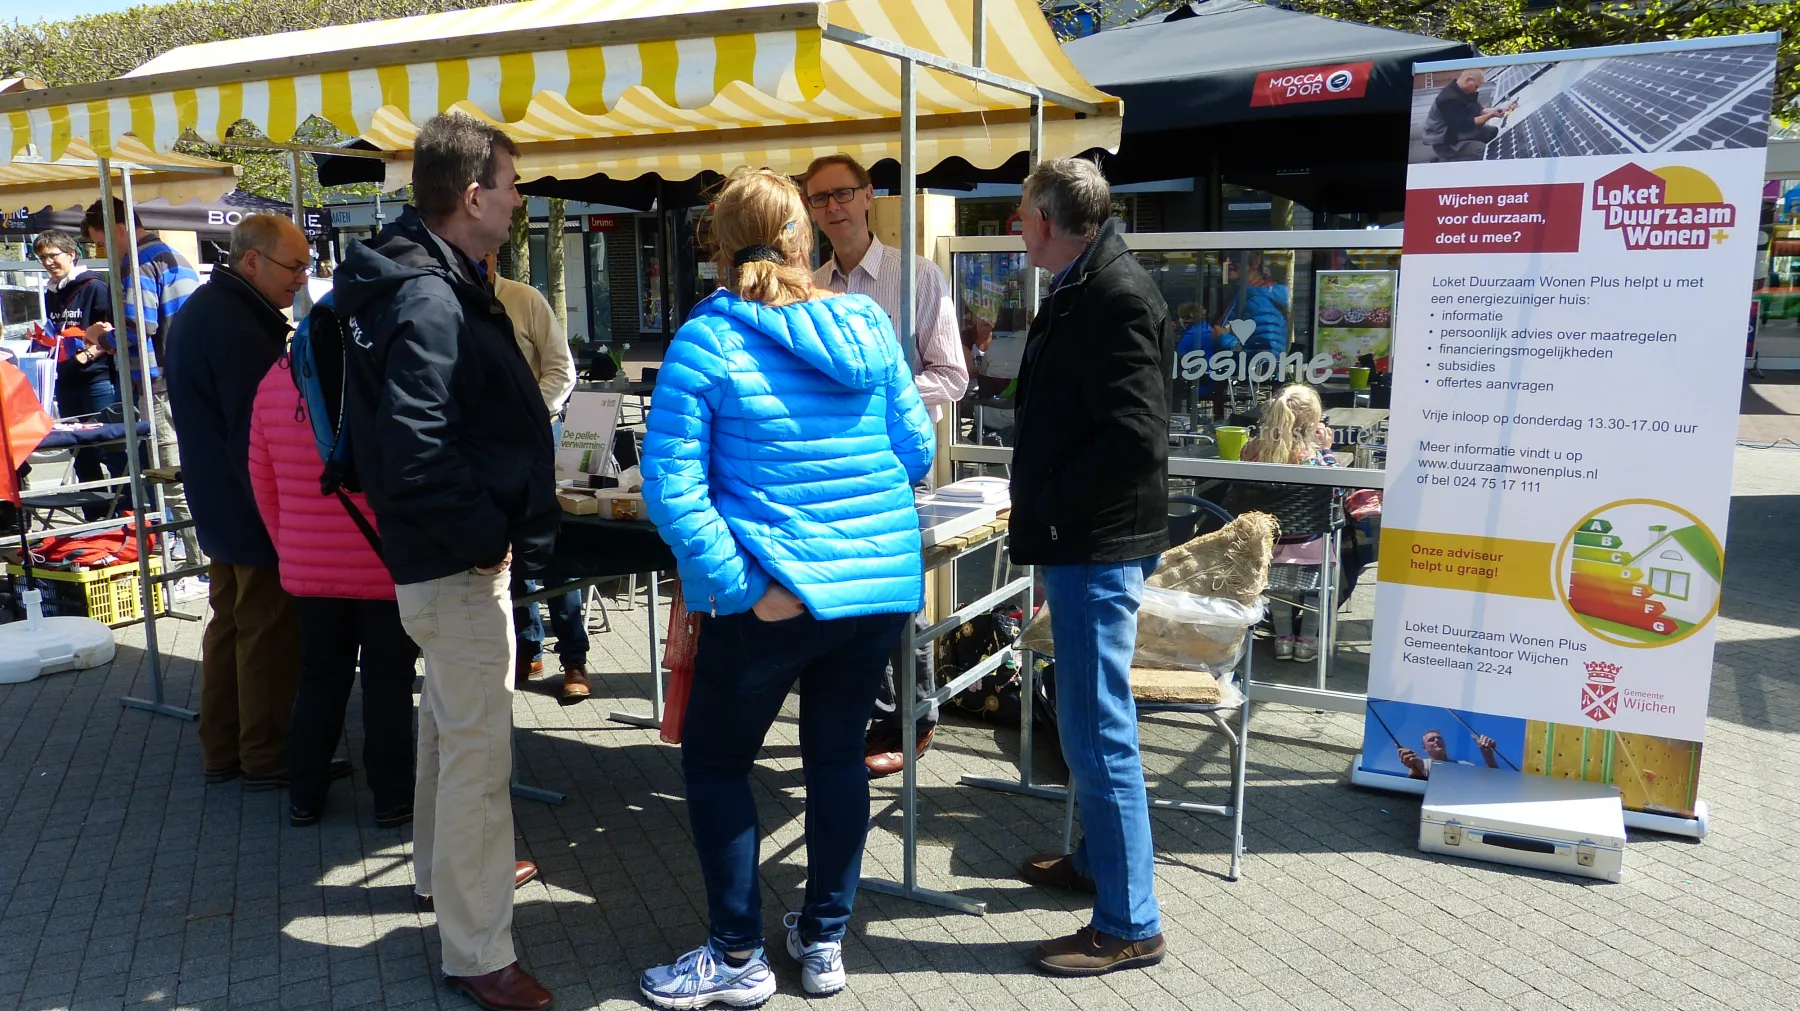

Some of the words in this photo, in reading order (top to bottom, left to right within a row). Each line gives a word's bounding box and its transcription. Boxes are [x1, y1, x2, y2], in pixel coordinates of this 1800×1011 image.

[1269, 73, 1323, 88] MOCCA
[1286, 83, 1322, 97] D'OR
[1439, 194, 1493, 208] Wijchen
[1498, 193, 1528, 206] gaat
[1597, 184, 1660, 205] Loket
[1437, 215, 1468, 224] voor
[1472, 213, 1545, 224] duurzaam,
[1609, 205, 1731, 225] Duurzaam
[1436, 233, 1465, 243] doet
[1470, 235, 1478, 243] u
[1483, 231, 1521, 242] mee?
[1433, 277, 1465, 286] Loket
[1470, 277, 1534, 287] Duurzaam
[1540, 277, 1585, 287] Wonen
[1591, 277, 1619, 287] Plus
[1625, 277, 1658, 289] helpt
[1664, 279, 1671, 287] u
[1677, 277, 1703, 287] met
[1431, 295, 1453, 304] een
[1457, 294, 1555, 307] energiezuiniger
[1559, 294, 1590, 304] huis:
[1442, 310, 1503, 321] informatie
[1441, 328, 1506, 340] persoonlijk
[1512, 329, 1552, 339] advies
[1558, 331, 1586, 340] over
[1591, 331, 1676, 344] maatregelen
[1440, 344, 1612, 359] financieringsmogelijkheden
[1438, 361, 1495, 372] subsidies
[1437, 377, 1482, 388] offertes
[1487, 381, 1553, 393] aanvragen
[1423, 410, 1448, 422] Vrije
[1452, 412, 1489, 424] inloop
[1494, 416, 1508, 425] op
[1513, 414, 1582, 430] donderdag
[1589, 418, 1669, 432] 13.30-17.00
[1675, 425, 1698, 433] uur
[563, 430, 574, 439] De
[561, 440, 606, 452] verwarming
[1420, 441, 1450, 452] Meer
[1454, 444, 1515, 456] informatie
[1520, 448, 1549, 458] vindt
[1567, 453, 1582, 463] op
[1418, 460, 1598, 480] www.duurzaamwonenplus.nl
[1417, 474, 1428, 483] of
[1432, 475, 1449, 485] bel
[1454, 476, 1476, 487] 024
[1482, 478, 1496, 488] 75
[1502, 480, 1516, 490] 17
[1522, 481, 1539, 492] 111
[1590, 521, 1602, 531] A
[1601, 537, 1612, 546] B
[1411, 544, 1443, 556] Onze
[1447, 548, 1503, 562] adviseur
[1611, 553, 1622, 562] C
[1410, 559, 1441, 572] helpt
[1446, 564, 1453, 572] u
[1457, 565, 1498, 579] graag!
[1620, 570, 1631, 578] D
[1632, 587, 1642, 596] E
[1644, 605, 1654, 613] F
[1653, 622, 1664, 631] G
[1406, 621, 1438, 633] Loket
[1443, 625, 1505, 641] Duurzaam
[1510, 633, 1553, 647] Wonen
[1559, 639, 1586, 651] Plus
[1404, 637, 1513, 659] Gemeentekantoor
[1518, 651, 1568, 665] Wijchen
[1404, 653, 1473, 670] Kasteellaan
[1477, 662, 1512, 675] 22-24
[1624, 689, 1664, 699] Gemeente
[1624, 697, 1675, 713] Wijchen
